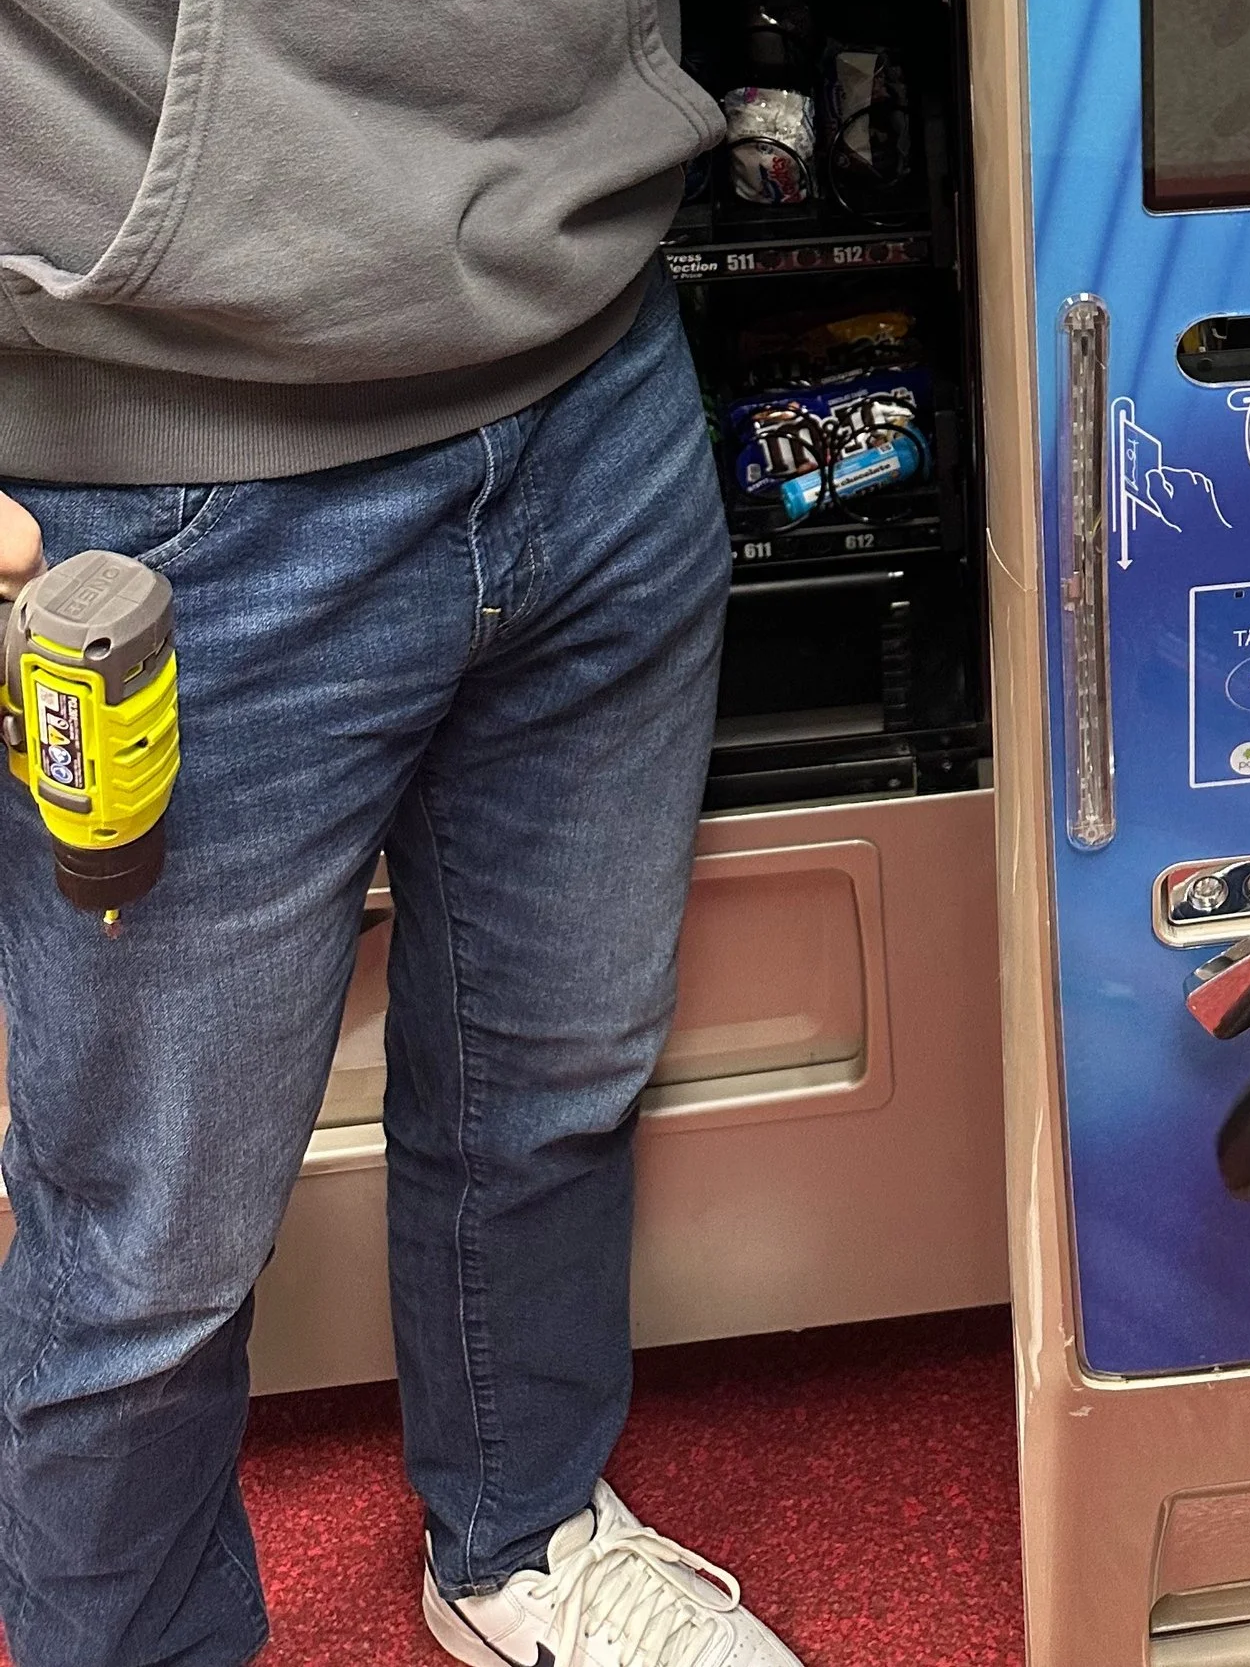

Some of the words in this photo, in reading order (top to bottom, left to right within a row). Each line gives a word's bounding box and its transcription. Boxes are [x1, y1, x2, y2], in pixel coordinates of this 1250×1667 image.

[727, 253, 755, 271] 511
[833, 245, 863, 264] 512
[669, 262, 718, 274] lection
[844, 533, 875, 550] 612
[744, 542, 772, 559] 611
